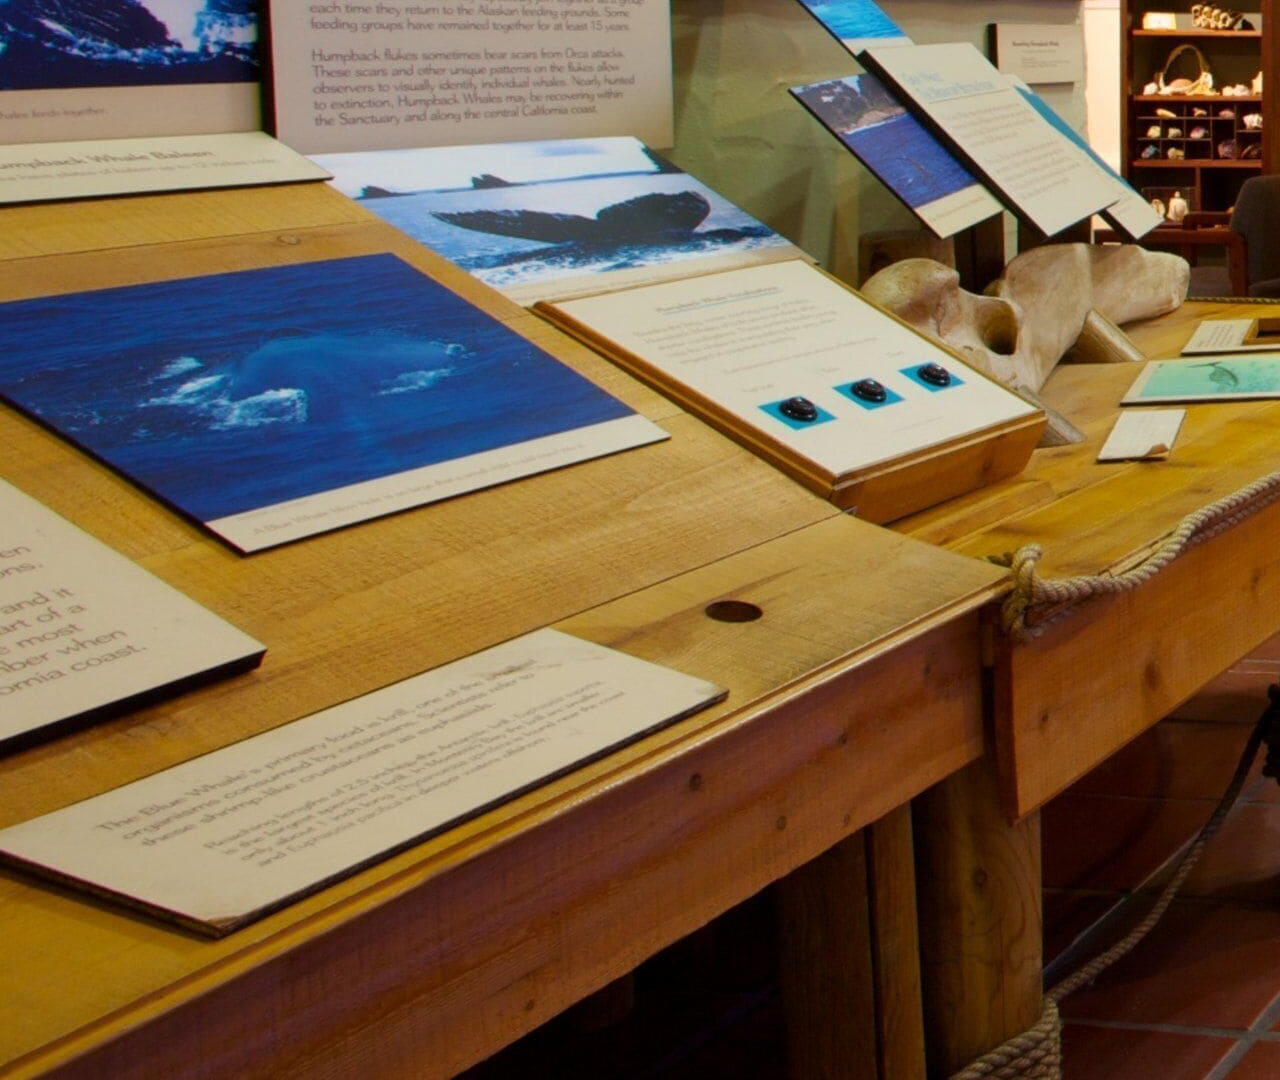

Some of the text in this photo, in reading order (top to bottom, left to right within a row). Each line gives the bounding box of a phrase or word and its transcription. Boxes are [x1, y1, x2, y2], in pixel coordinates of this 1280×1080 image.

[0, 587, 75, 614] and it
[15, 623, 82, 648] most
[55, 630, 127, 654] when
[70, 644, 146, 672] coast.
